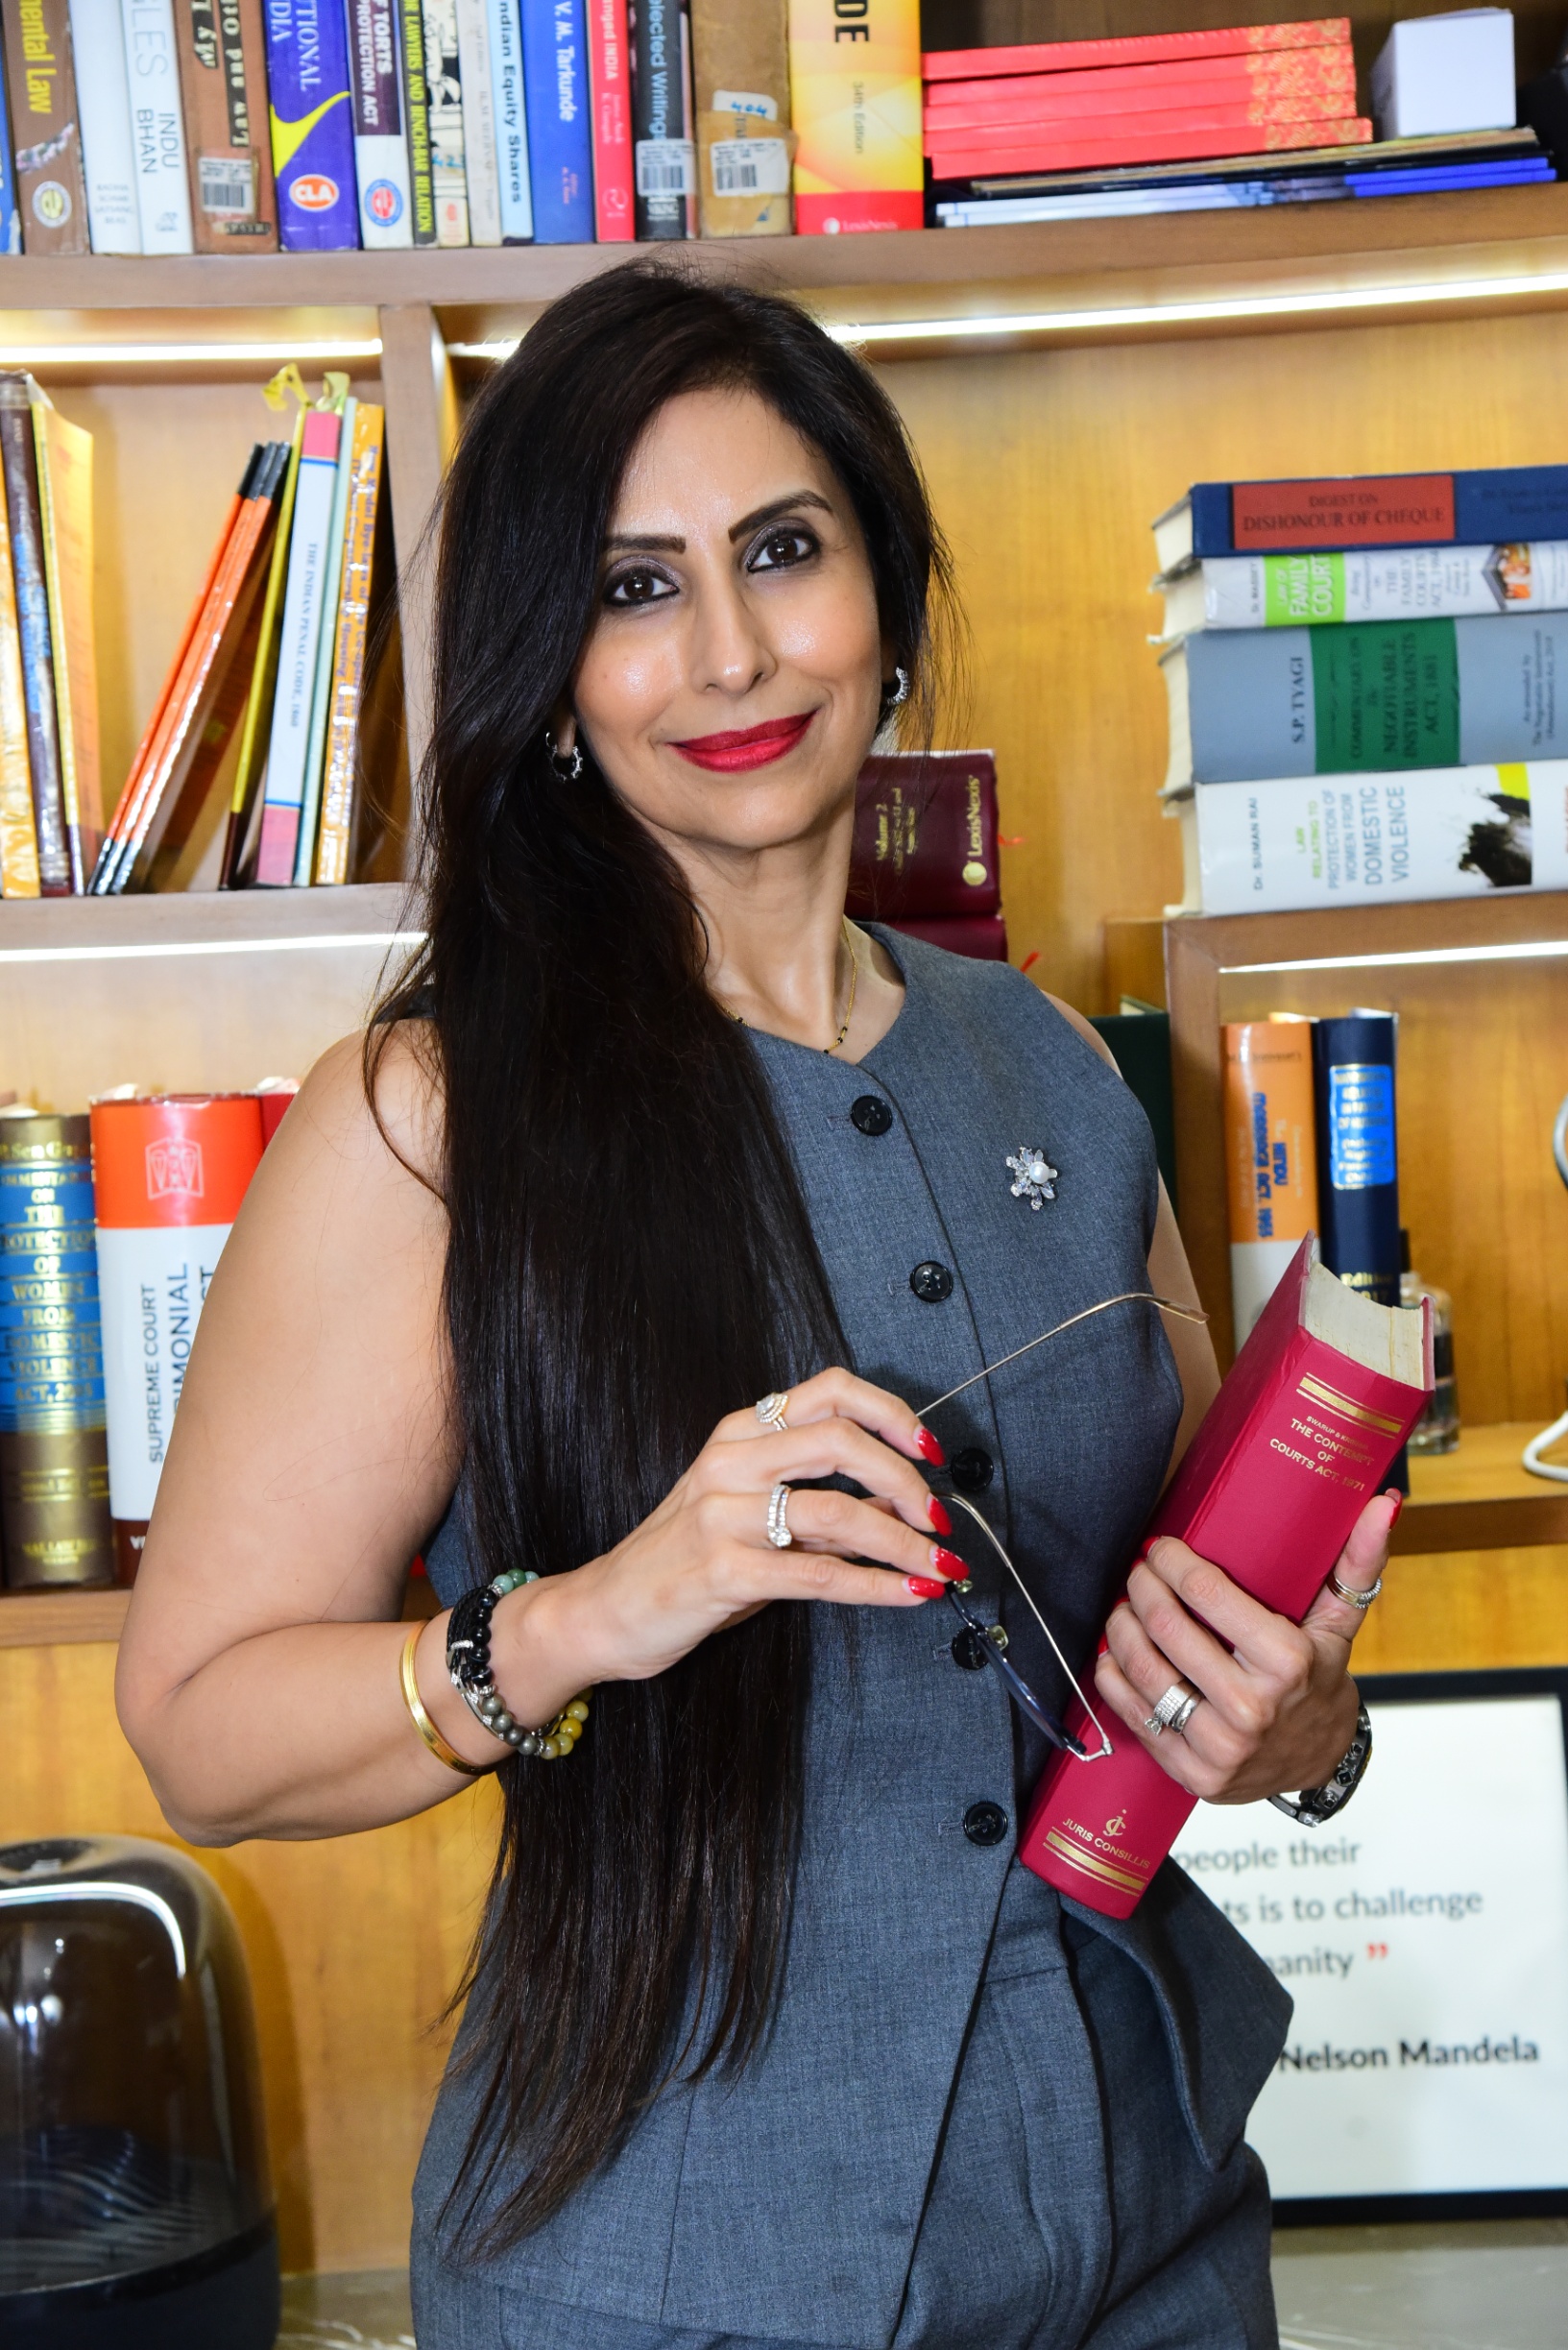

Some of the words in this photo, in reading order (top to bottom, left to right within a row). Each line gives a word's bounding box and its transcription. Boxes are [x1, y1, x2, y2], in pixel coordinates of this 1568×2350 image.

[271, 0, 292, 42] DIA
[555, 1, 572, 16] V.
[555, 21, 573, 41] M.
[131, 0, 169, 76] LES
[356, 0, 376, 92] ROTECTION
[373, 11, 393, 75] TORTS
[404, 16, 423, 70] LAWYERS
[557, 46, 577, 122] Tarkunde
[605, 43, 618, 81] INDIA
[26, 68, 57, 113] Law
[363, 95, 379, 126] ACT
[408, 74, 425, 101] AND
[502, 64, 519, 127] Equity
[137, 109, 158, 174] BHAN
[158, 112, 180, 168] INDU
[410, 105, 429, 172] BENCH-BAR
[854, 112, 866, 154] Edition
[508, 135, 521, 203] Shares
[296, 185, 332, 202] CLA
[415, 175, 432, 232] RELATION
[842, 219, 898, 231] LexisNexis
[1242, 511, 1344, 530] DISHONOUR
[1347, 510, 1369, 525] OF
[1374, 506, 1444, 524] CHEQUE
[1309, 494, 1356, 508] DIGEST
[1359, 493, 1378, 506] ON
[307, 543, 318, 566] THE
[302, 570, 317, 618] INDIAN
[1290, 556, 1309, 617] FAMILY
[1311, 554, 1333, 617] COURT
[296, 619, 310, 659] PENAL
[1291, 657, 1305, 711] TYAGI
[1383, 639, 1398, 753] NEGOTIABLE
[1401, 632, 1418, 758] INSTRUMENTS
[1291, 717, 1305, 743] S.P.
[1350, 661, 1363, 759] COMMENTARY
[967, 775, 982, 857] LexisNexis
[1248, 797, 1258, 818] RAI
[1308, 800, 1319, 815] TO
[1322, 789, 1336, 805] OF
[1341, 793, 1355, 829] FROM
[1251, 822, 1263, 869] SUMAN
[1325, 808, 1340, 890] PROTECTION
[1344, 832, 1358, 882] WOMEN
[1360, 787, 1383, 885] DOMESTIC
[1387, 786, 1410, 883] VIOLENCE
[1253, 876, 1264, 890] Dr.
[34, 1254, 60, 1274] OF
[12, 1280, 84, 1300] WOMEN
[23, 1305, 75, 1325] FROM
[141, 1284, 158, 1356] COURT
[145, 1361, 163, 1464] SUPREME
[1306, 1415, 1335, 1436] SWARUP
[1269, 1438, 1315, 1470] COURTS
[1315, 1466, 1339, 1484] ACT,
[1342, 1478, 1365, 1491] 1971
[1290, 1417, 1315, 1438] THE
[1314, 1432, 1375, 1467] CONTEMPT
[1316, 1450, 1335, 1464] OF
[1062, 1818, 1094, 1842] JURIS
[1094, 1837, 1151, 1869] CONSILLIS
[1289, 1836, 1362, 1868] their
[1260, 1894, 1283, 1924] is
[1293, 1896, 1325, 1923] to
[1334, 1887, 1484, 1926] challenge
[1278, 2041, 1388, 2073] Nelson
[1399, 2035, 1541, 2069] Mandela
